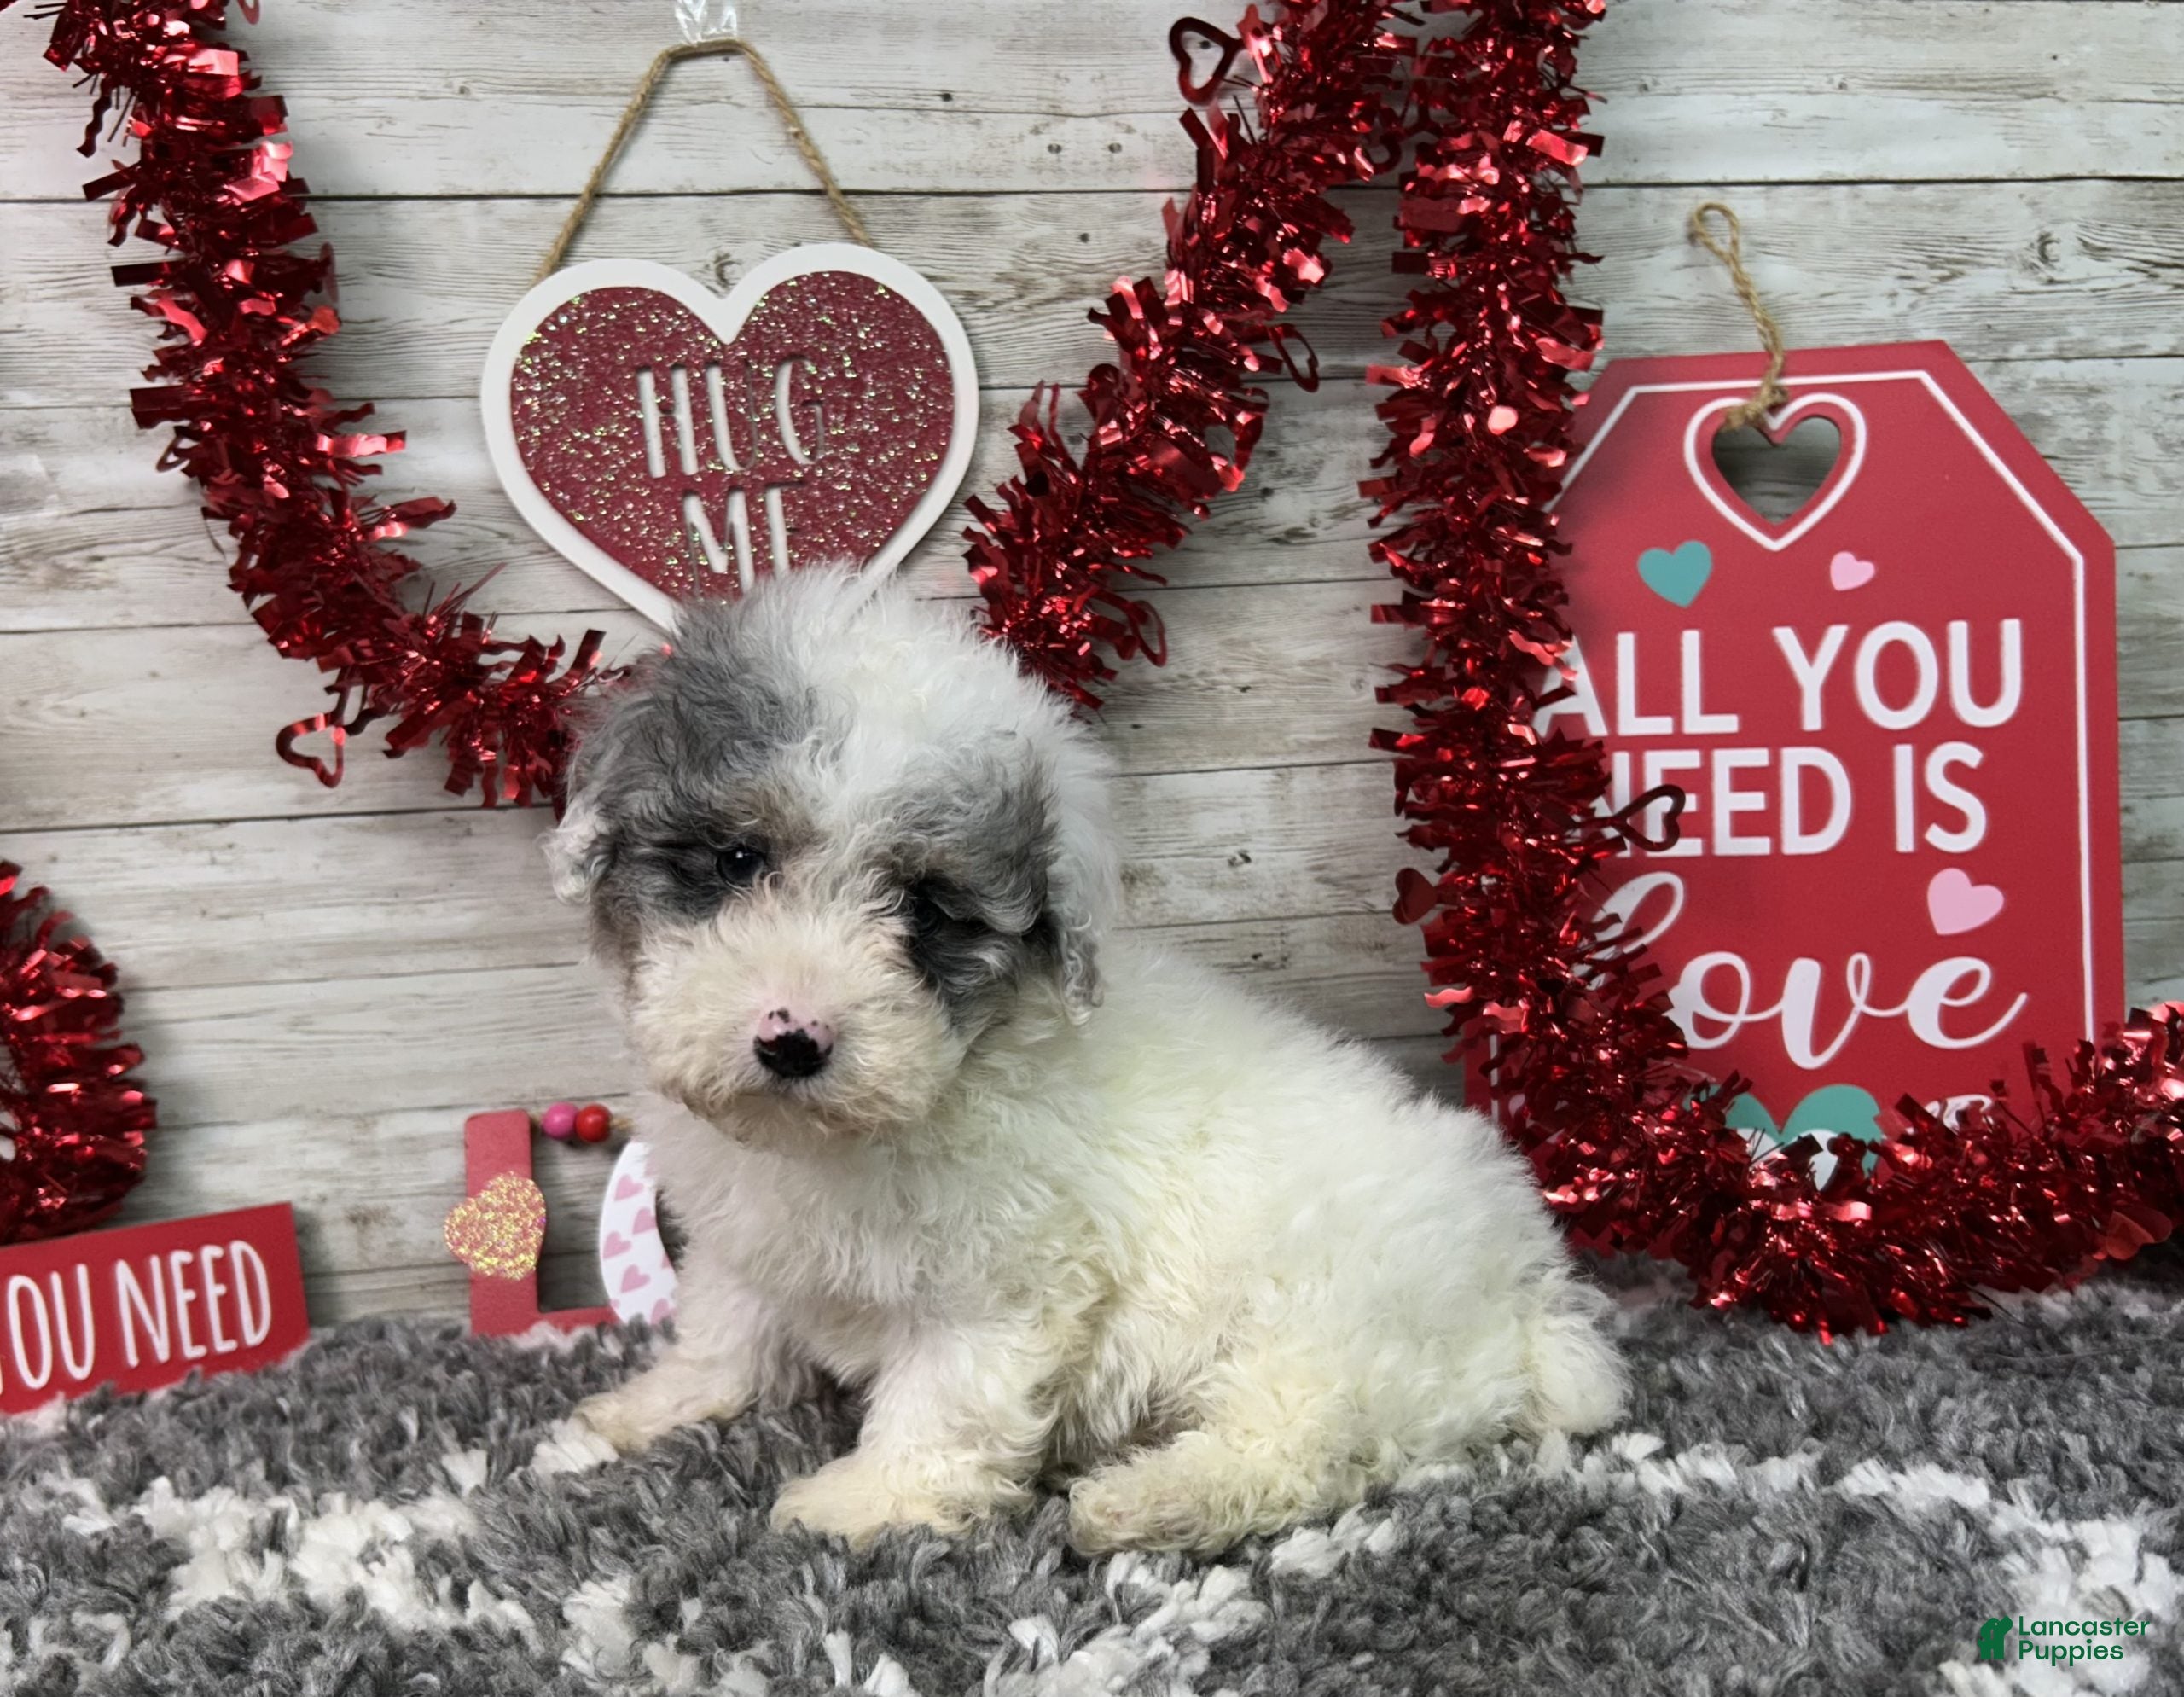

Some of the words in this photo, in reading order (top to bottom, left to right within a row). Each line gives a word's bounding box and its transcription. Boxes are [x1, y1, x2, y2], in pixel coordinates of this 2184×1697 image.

[636, 354, 824, 479] HUG
[682, 479, 807, 600] ME
[1532, 629, 1740, 737] ALL
[1773, 618, 2023, 732] YOU
[1893, 741, 1987, 853] IS
[0, 1263, 96, 1395] OU
[115, 1239, 272, 1368] NEED
